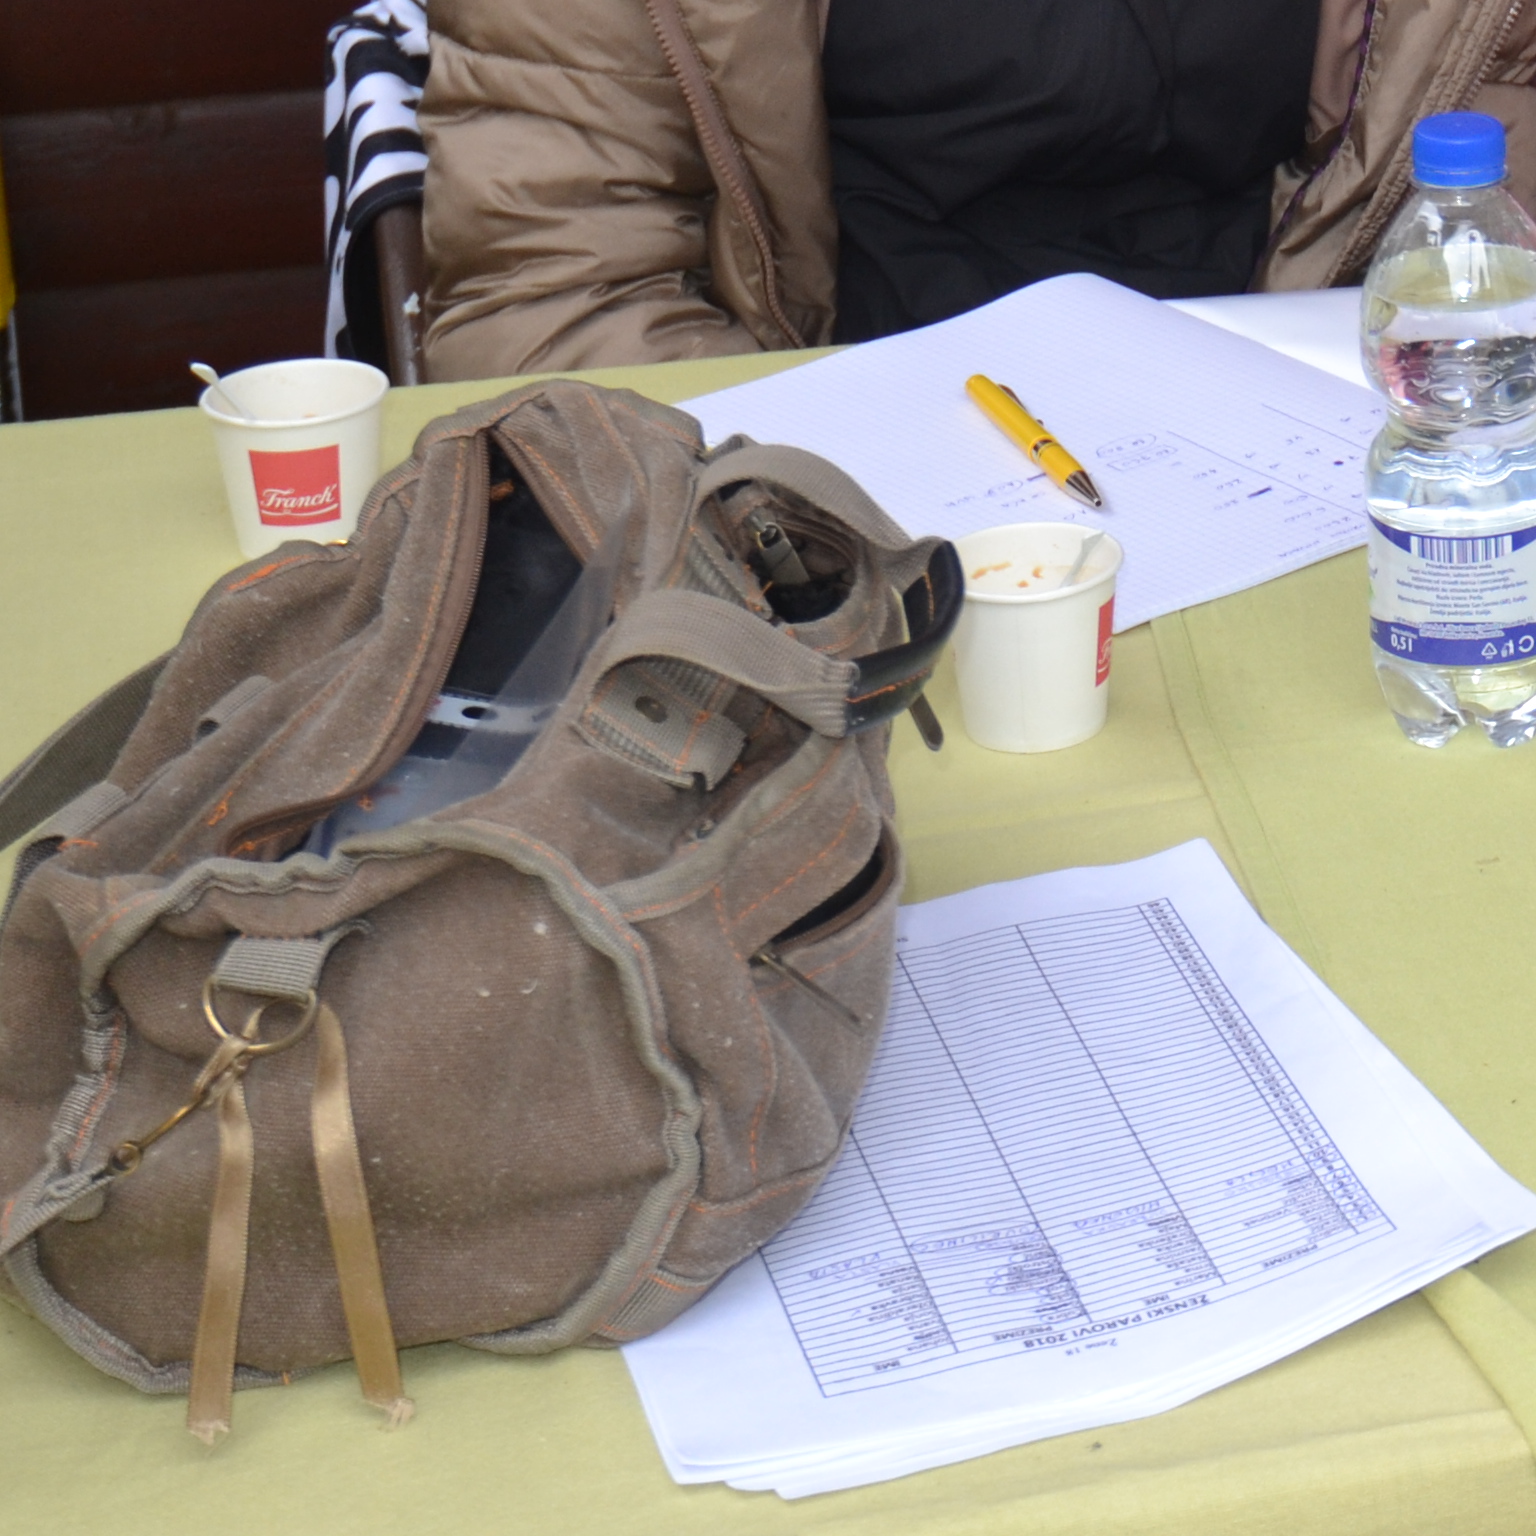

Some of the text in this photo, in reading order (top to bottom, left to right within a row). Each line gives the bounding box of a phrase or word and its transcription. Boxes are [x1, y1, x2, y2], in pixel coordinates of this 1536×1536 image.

[261, 483, 338, 510] Franck
[1023, 1293, 1210, 1349] ŽENSKI PAROVI 2018
